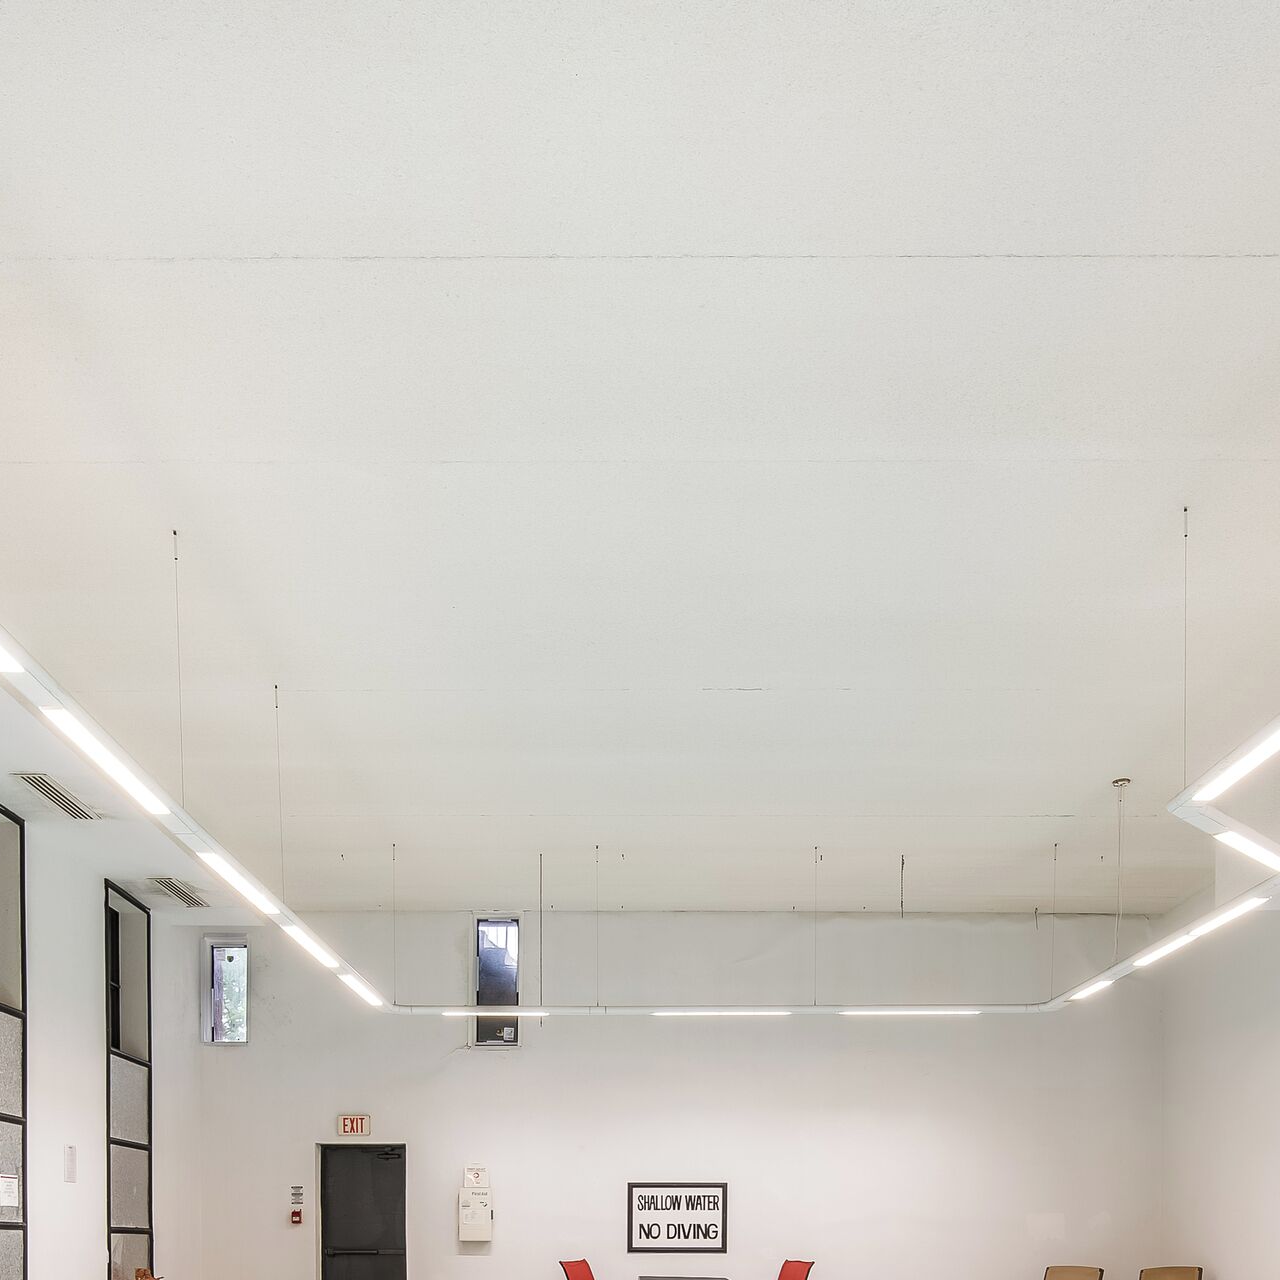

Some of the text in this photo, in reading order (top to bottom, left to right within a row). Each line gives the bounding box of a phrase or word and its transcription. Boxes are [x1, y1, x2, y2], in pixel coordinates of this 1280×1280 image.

[342, 1117, 365, 1134] EXIT
[637, 1194, 720, 1211] SHALLOW WATER
[639, 1223, 719, 1240] NO DIVING
